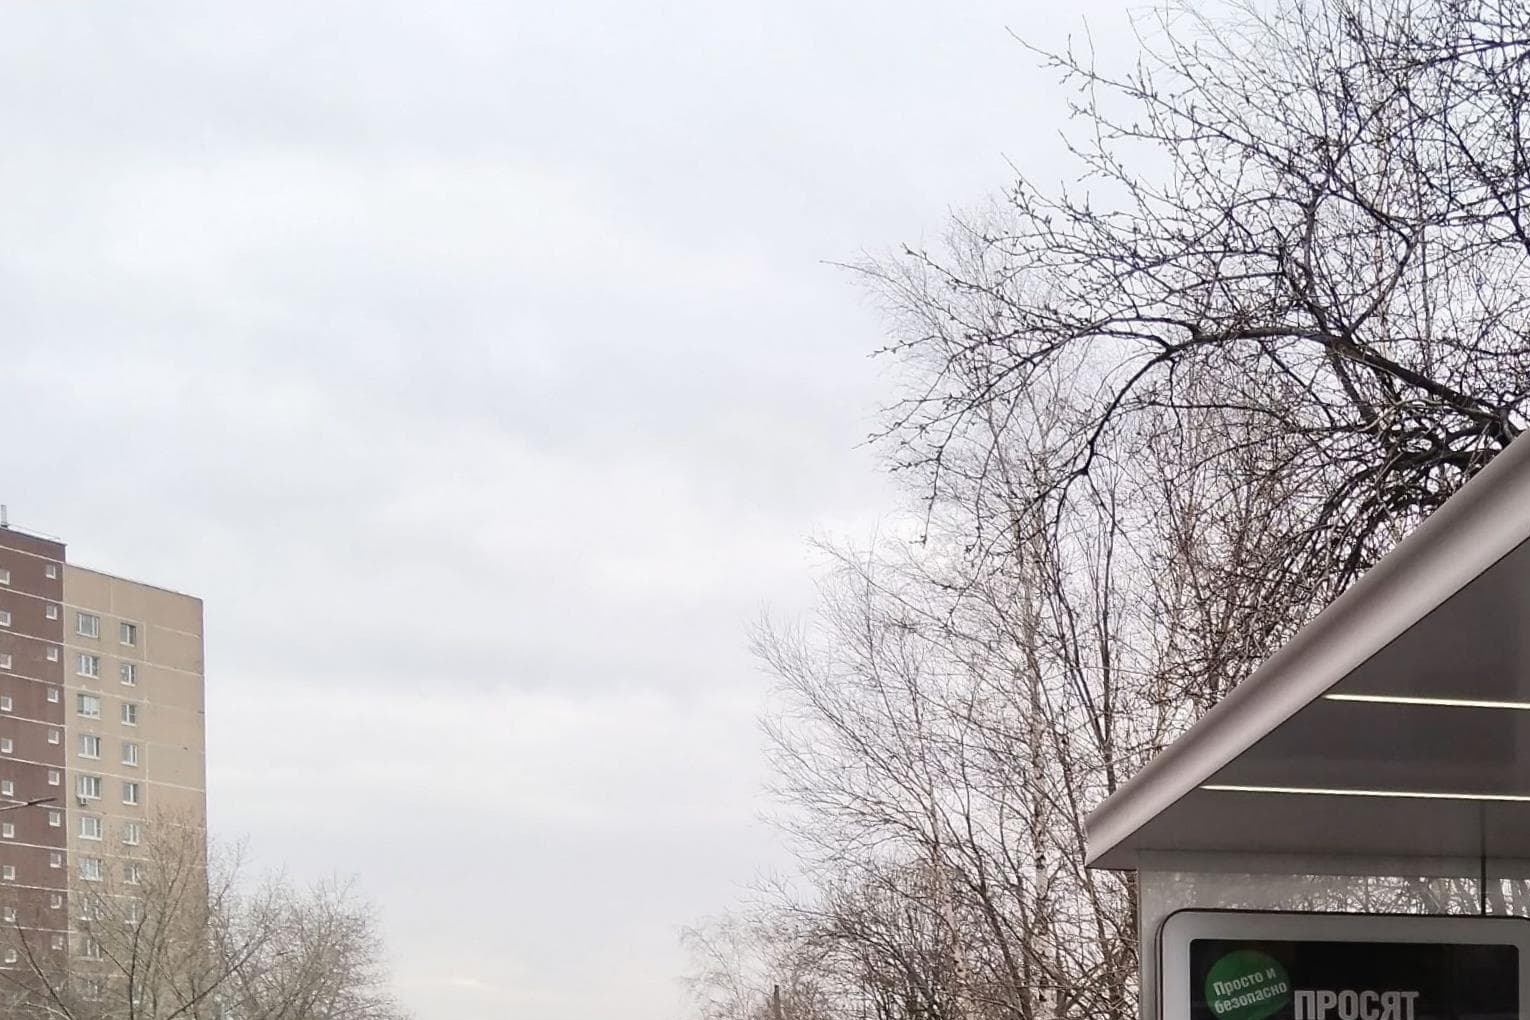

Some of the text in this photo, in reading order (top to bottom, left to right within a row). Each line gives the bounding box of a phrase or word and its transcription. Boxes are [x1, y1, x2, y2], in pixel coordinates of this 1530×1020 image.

[1213, 967, 1277, 996] Просто и
[1214, 982, 1288, 1014] безопасно
[1294, 990, 1419, 1020] ПРОСЯТ
